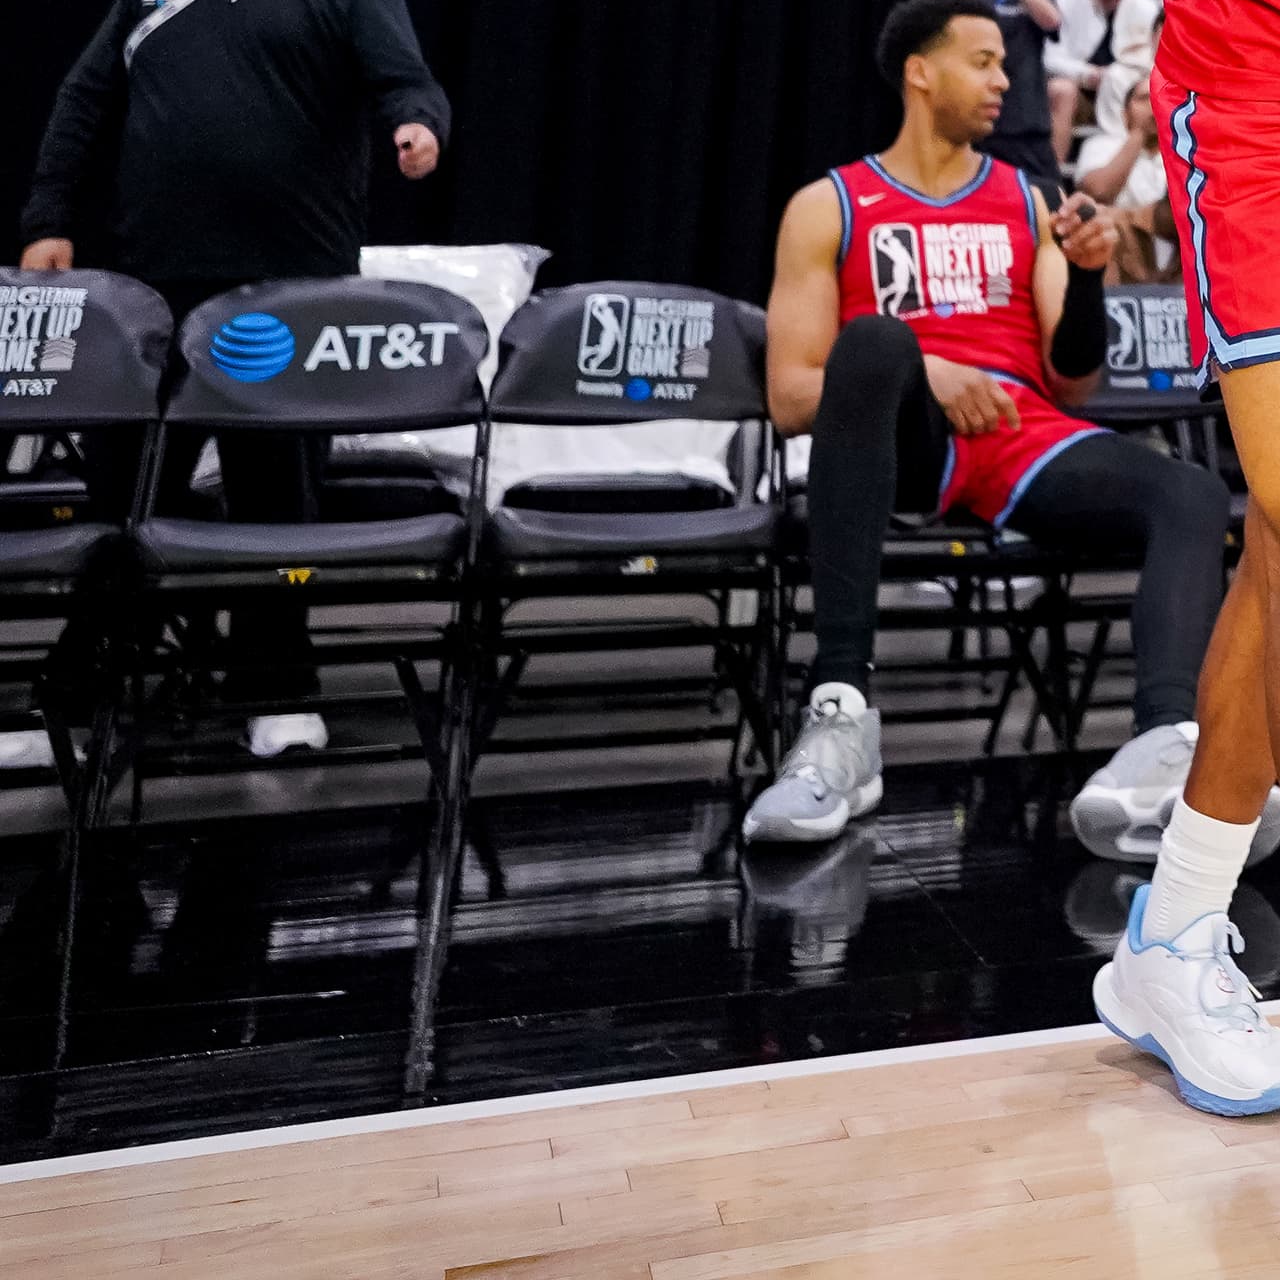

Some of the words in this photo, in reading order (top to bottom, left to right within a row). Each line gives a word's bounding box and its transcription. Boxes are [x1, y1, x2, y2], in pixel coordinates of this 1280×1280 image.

[924, 242, 983, 278] NEXT
[982, 242, 1014, 277] UP
[0, 306, 49, 340] EXT
[46, 305, 84, 339] UP
[303, 322, 460, 372] AT&T
[3, 378, 58, 397] AT&T
